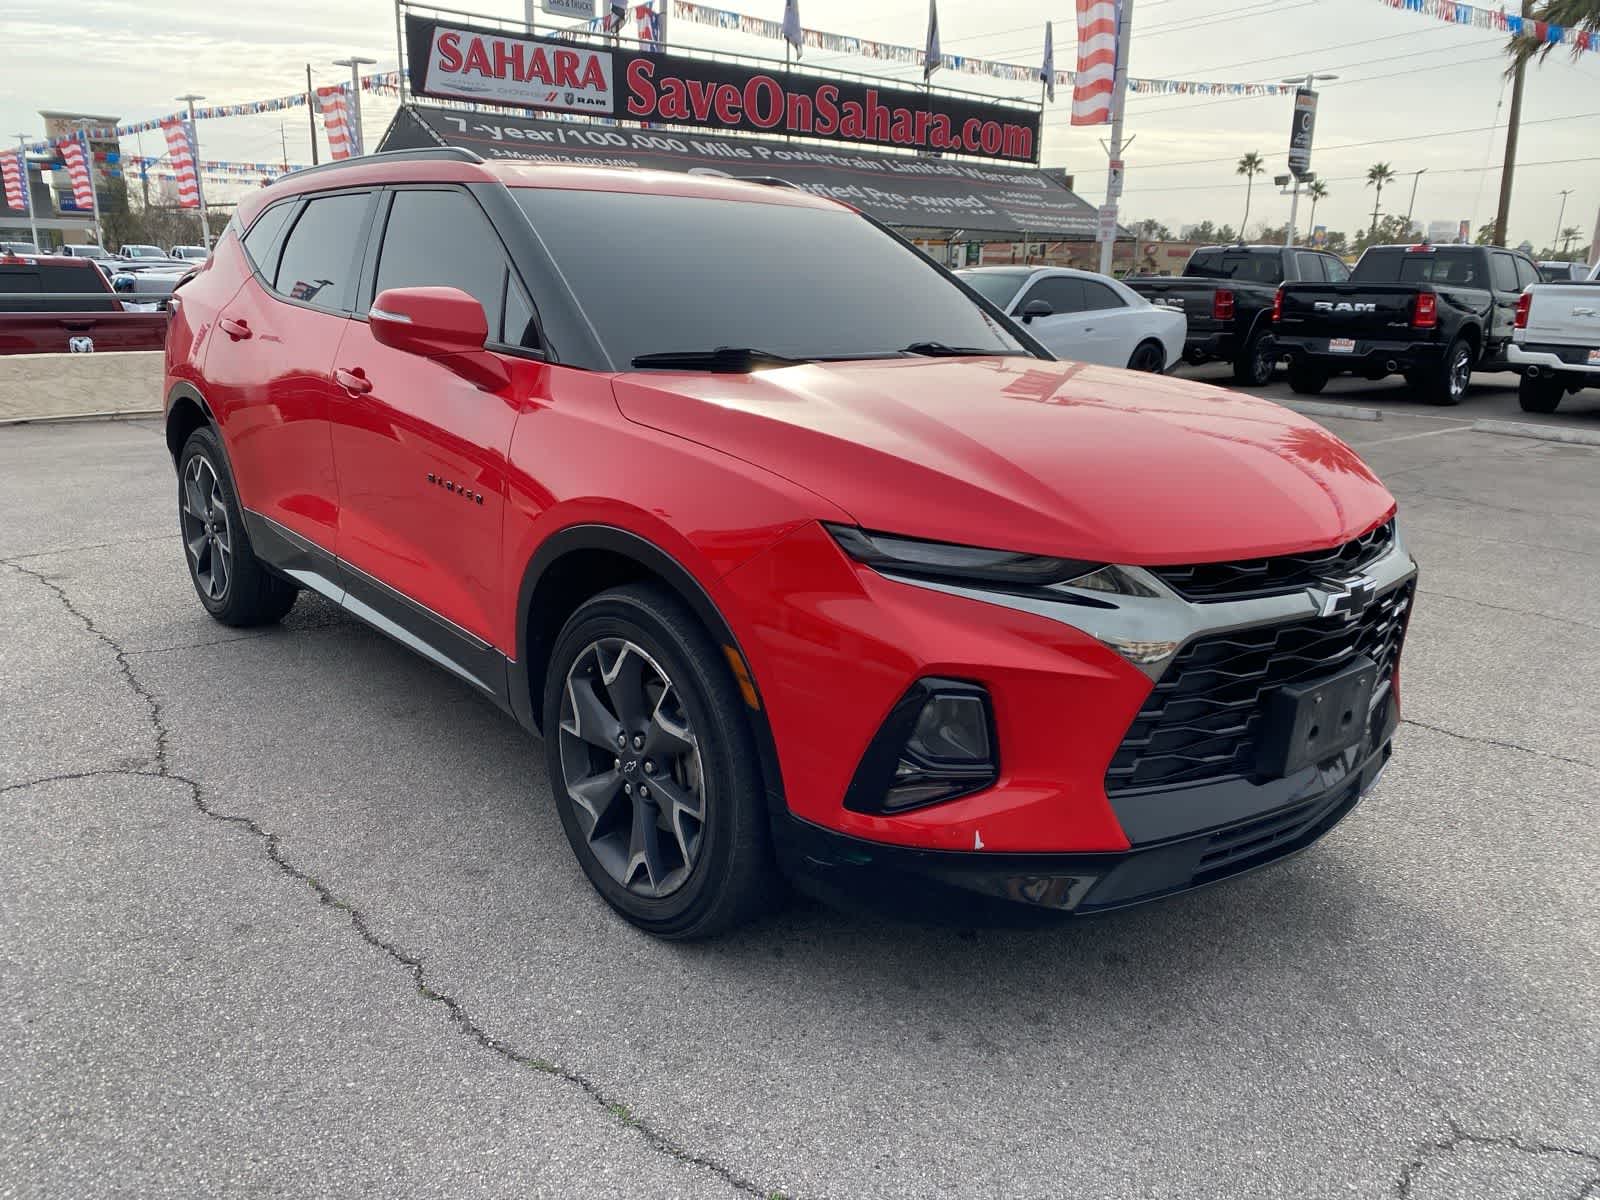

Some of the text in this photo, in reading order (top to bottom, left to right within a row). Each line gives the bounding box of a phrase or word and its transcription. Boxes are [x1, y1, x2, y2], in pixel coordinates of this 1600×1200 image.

[438, 31, 609, 92] SAHARA
[577, 96, 607, 106] RAM
[626, 57, 1033, 159] SaveOnSahara.com
[444, 116, 1048, 189] 7-year/100,000 Mile Powertrain Limited Warranty
[862, 186, 986, 207] Pre-owned
[1314, 301, 1376, 312] RAM
